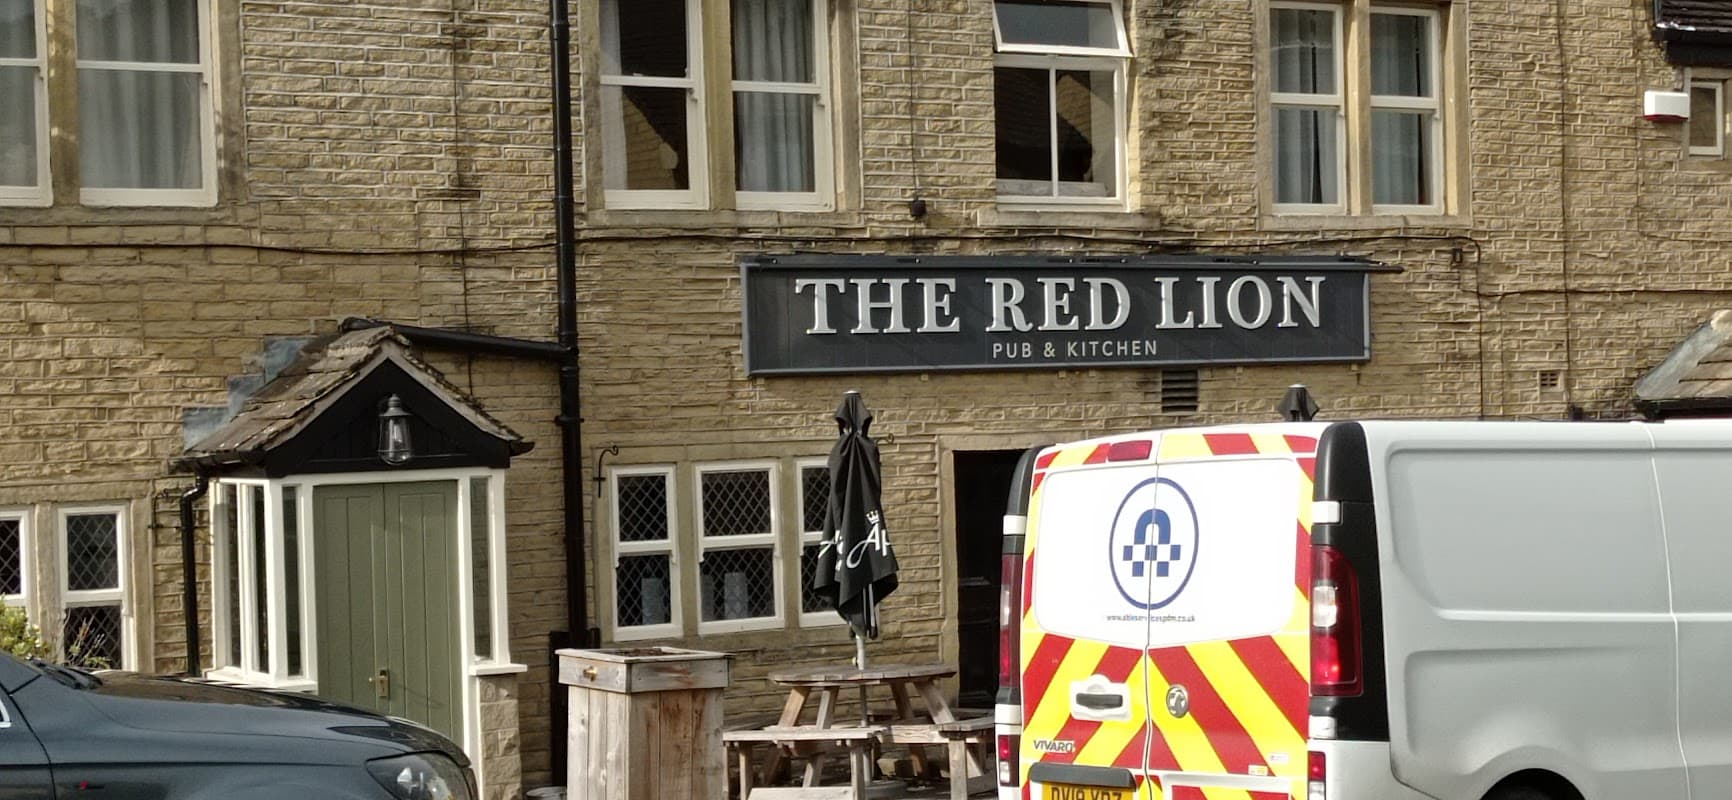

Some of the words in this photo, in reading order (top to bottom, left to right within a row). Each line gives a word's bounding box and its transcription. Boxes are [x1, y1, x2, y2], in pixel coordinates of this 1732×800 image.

[795, 277, 961, 335] THE
[985, 276, 1131, 333] RED
[1154, 275, 1326, 330] LION
[992, 343, 1032, 359] PUB
[1043, 341, 1056, 358] &
[1067, 340, 1158, 358] KITCHEN
[1033, 740, 1074, 753] VIVARO
